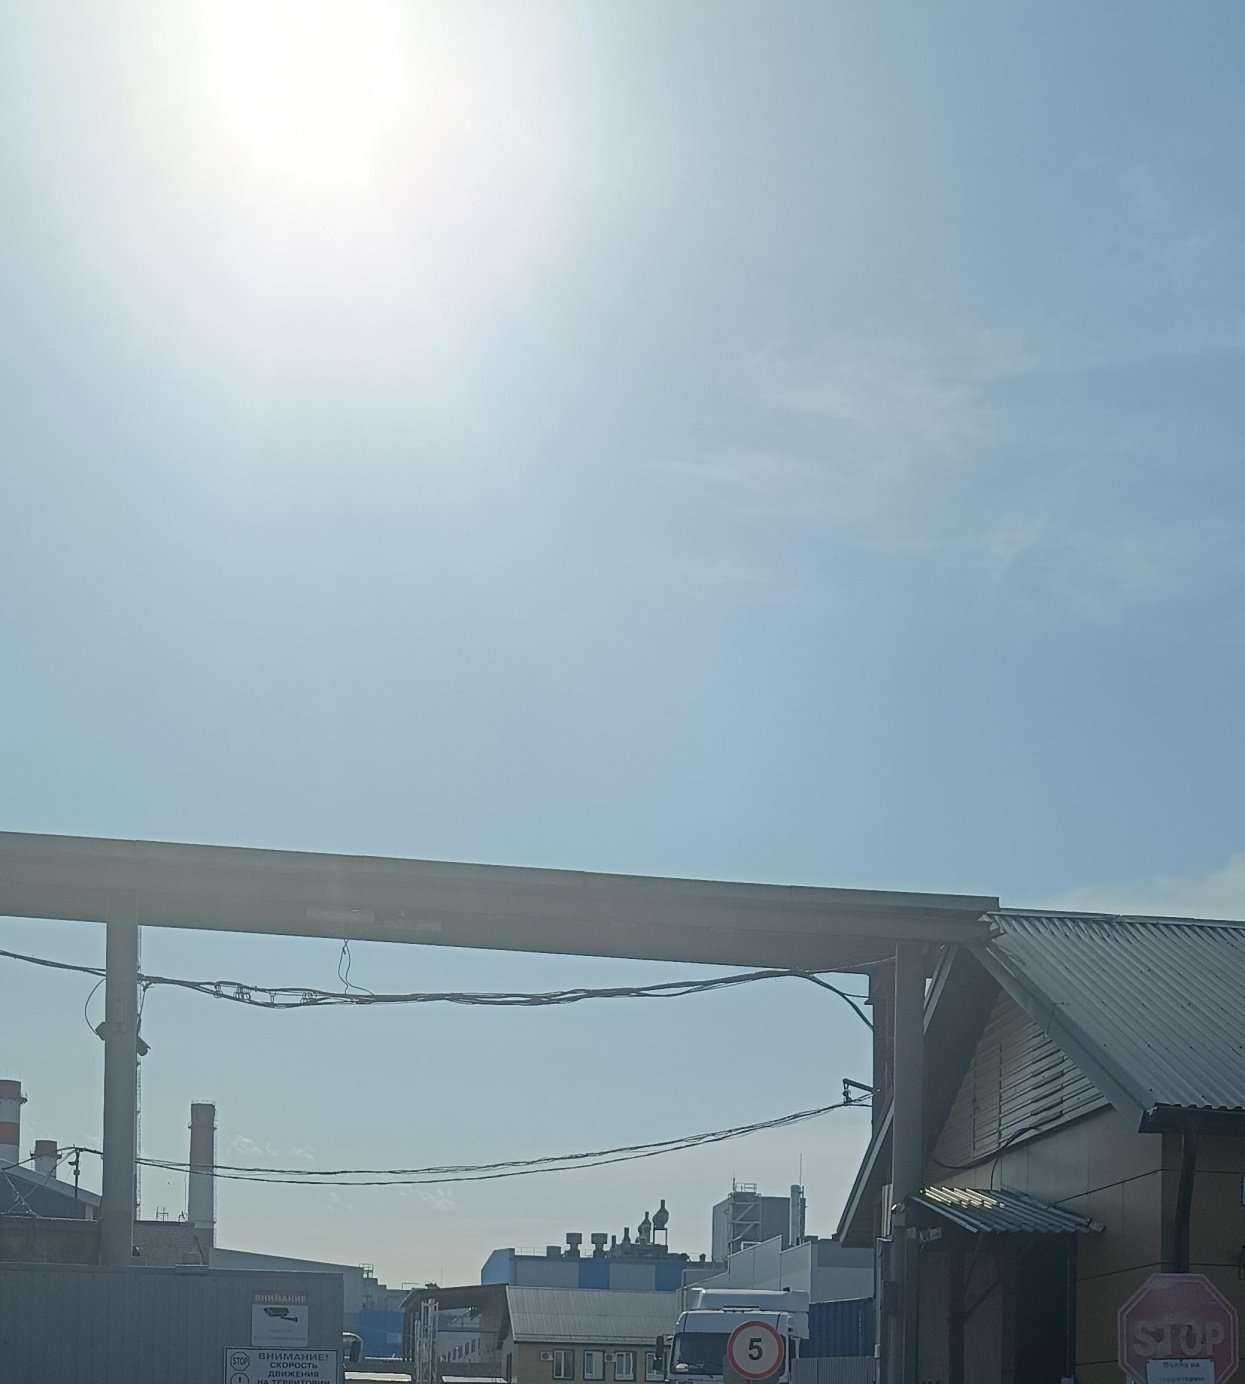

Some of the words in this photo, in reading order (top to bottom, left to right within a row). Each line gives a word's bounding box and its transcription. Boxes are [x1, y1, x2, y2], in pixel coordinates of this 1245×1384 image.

[1134, 1320, 1225, 1356] STOP
[748, 1337, 763, 1360] 5
[270, 1361, 318, 1369] СКОРОСТЬ
[268, 1370, 319, 1378] ДВИЖЕНИЯ
